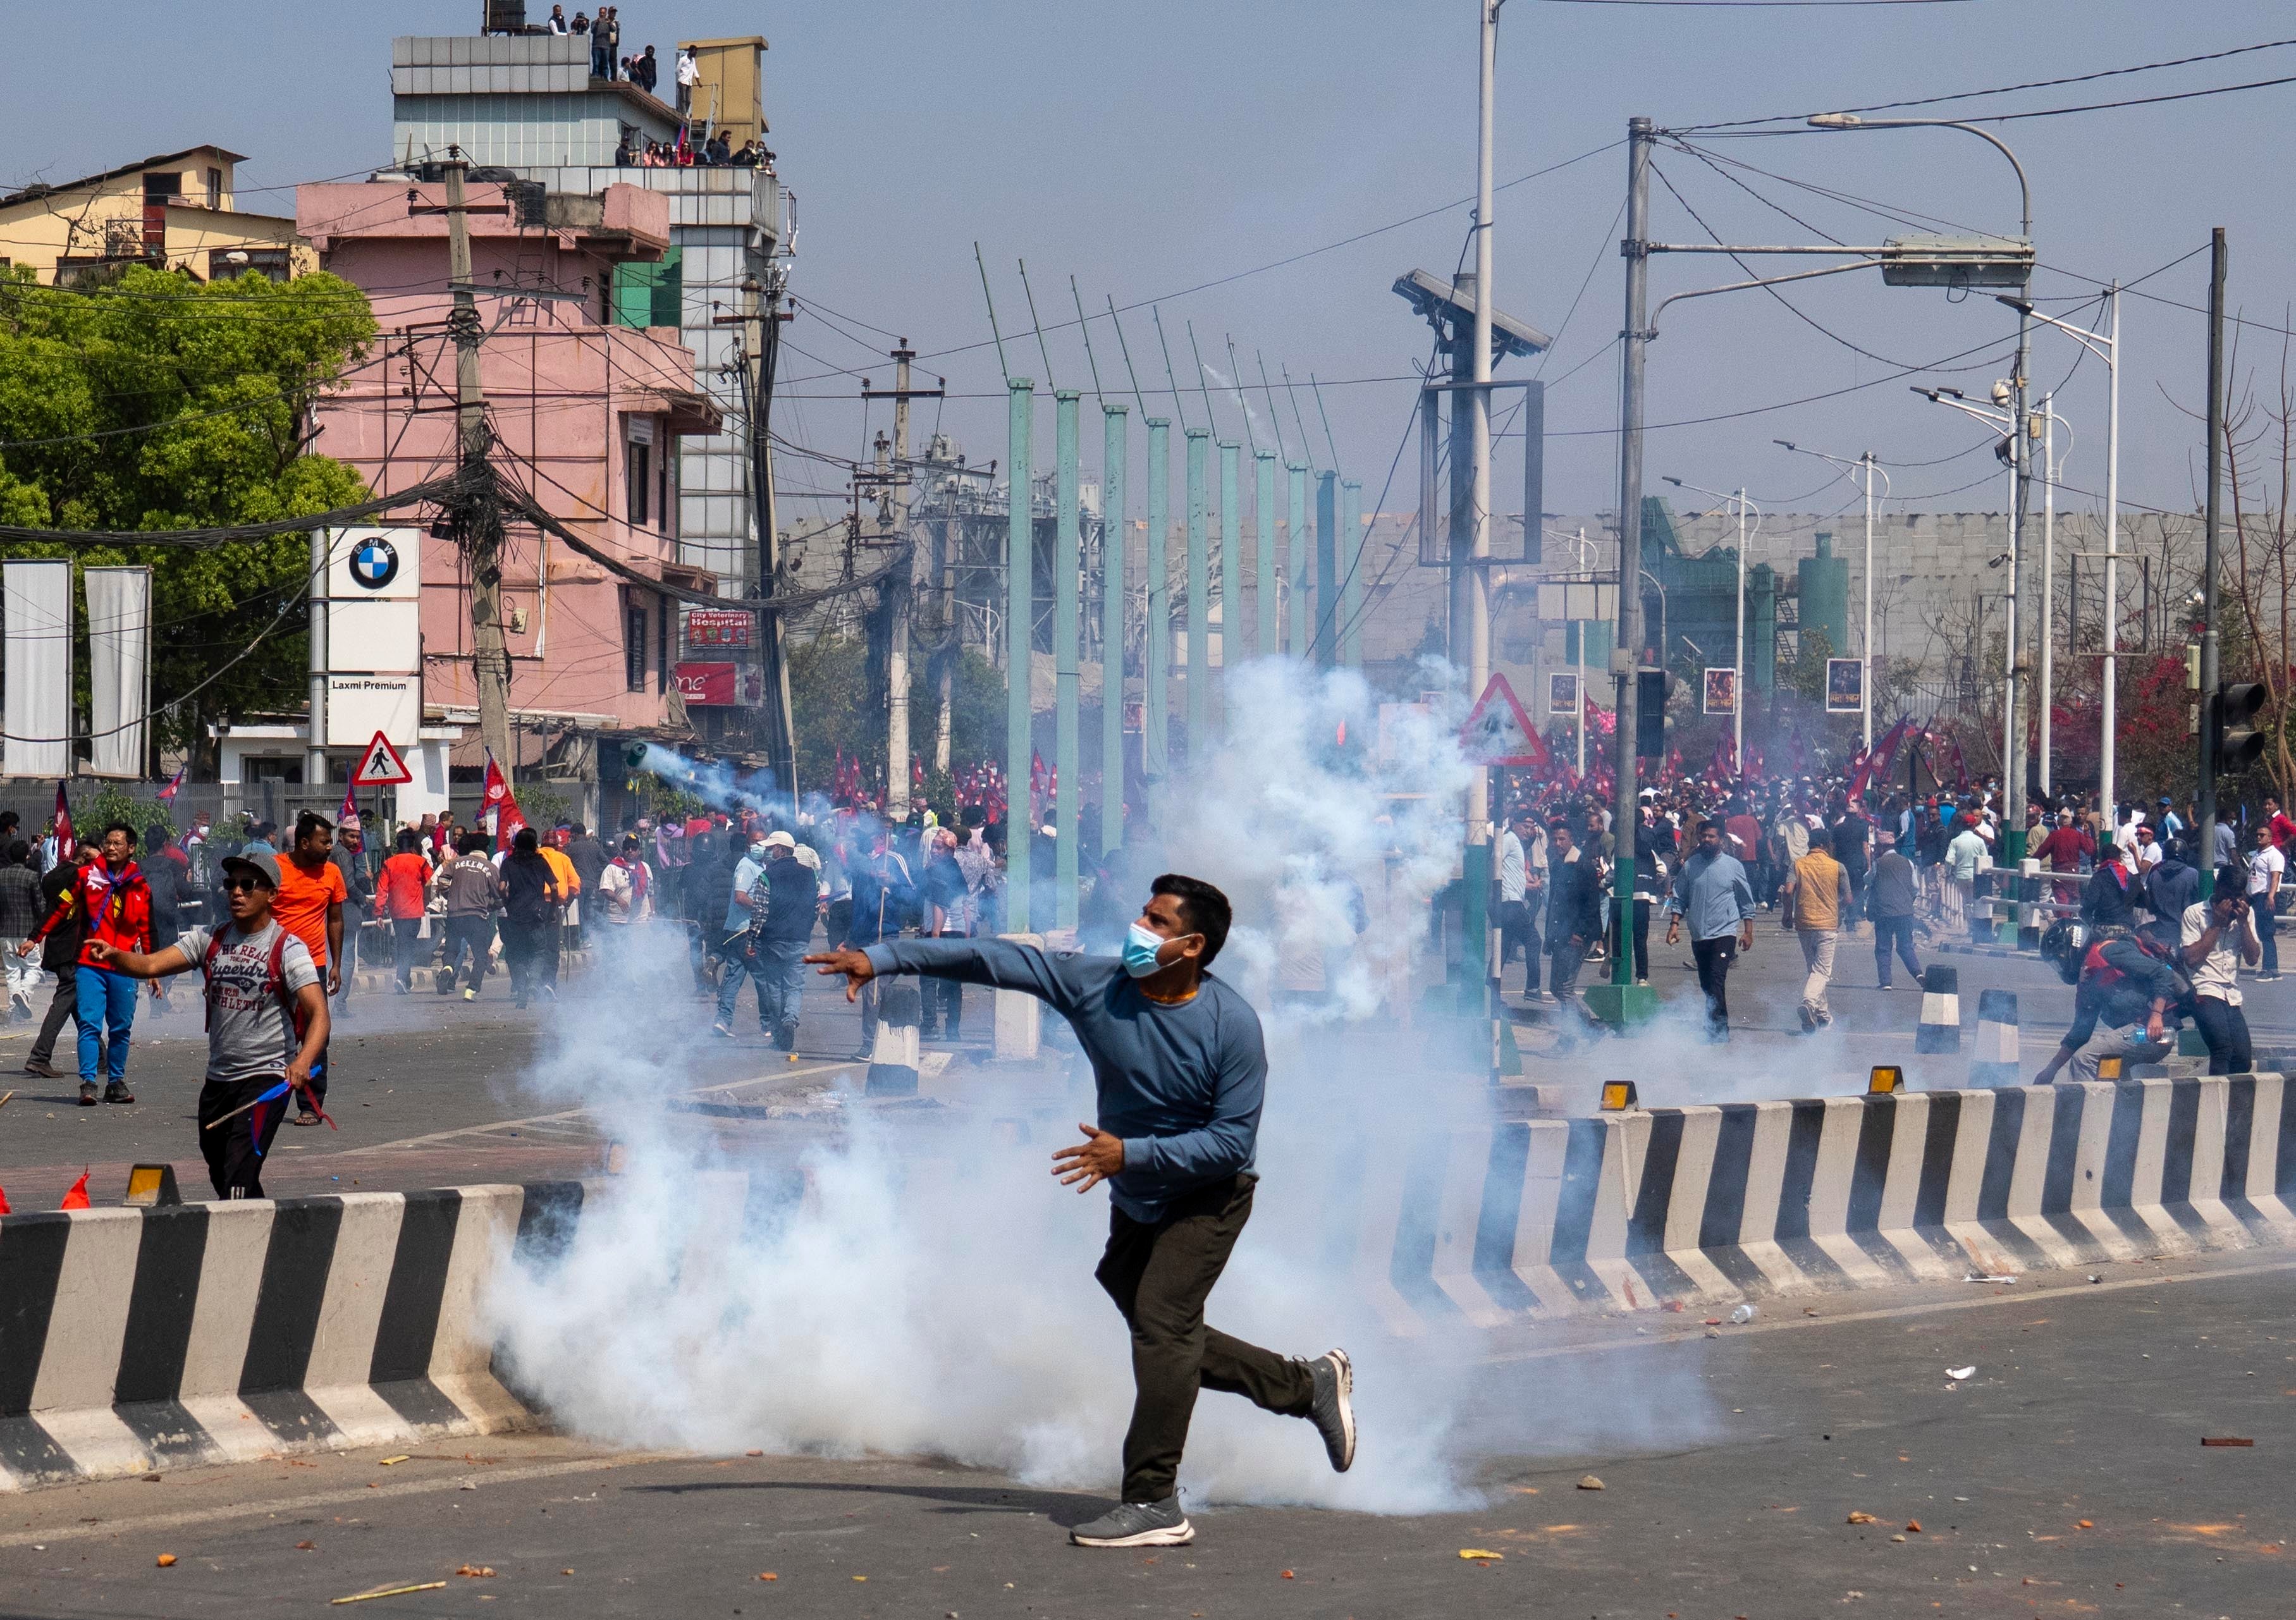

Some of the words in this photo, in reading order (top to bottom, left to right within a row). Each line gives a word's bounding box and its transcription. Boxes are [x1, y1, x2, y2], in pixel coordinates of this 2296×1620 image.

[354, 538, 394, 555] BMW
[691, 619, 747, 627] Hospital
[333, 680, 361, 690] Laxmi
[364, 680, 407, 690] Premium
[240, 945, 269, 963] REAL
